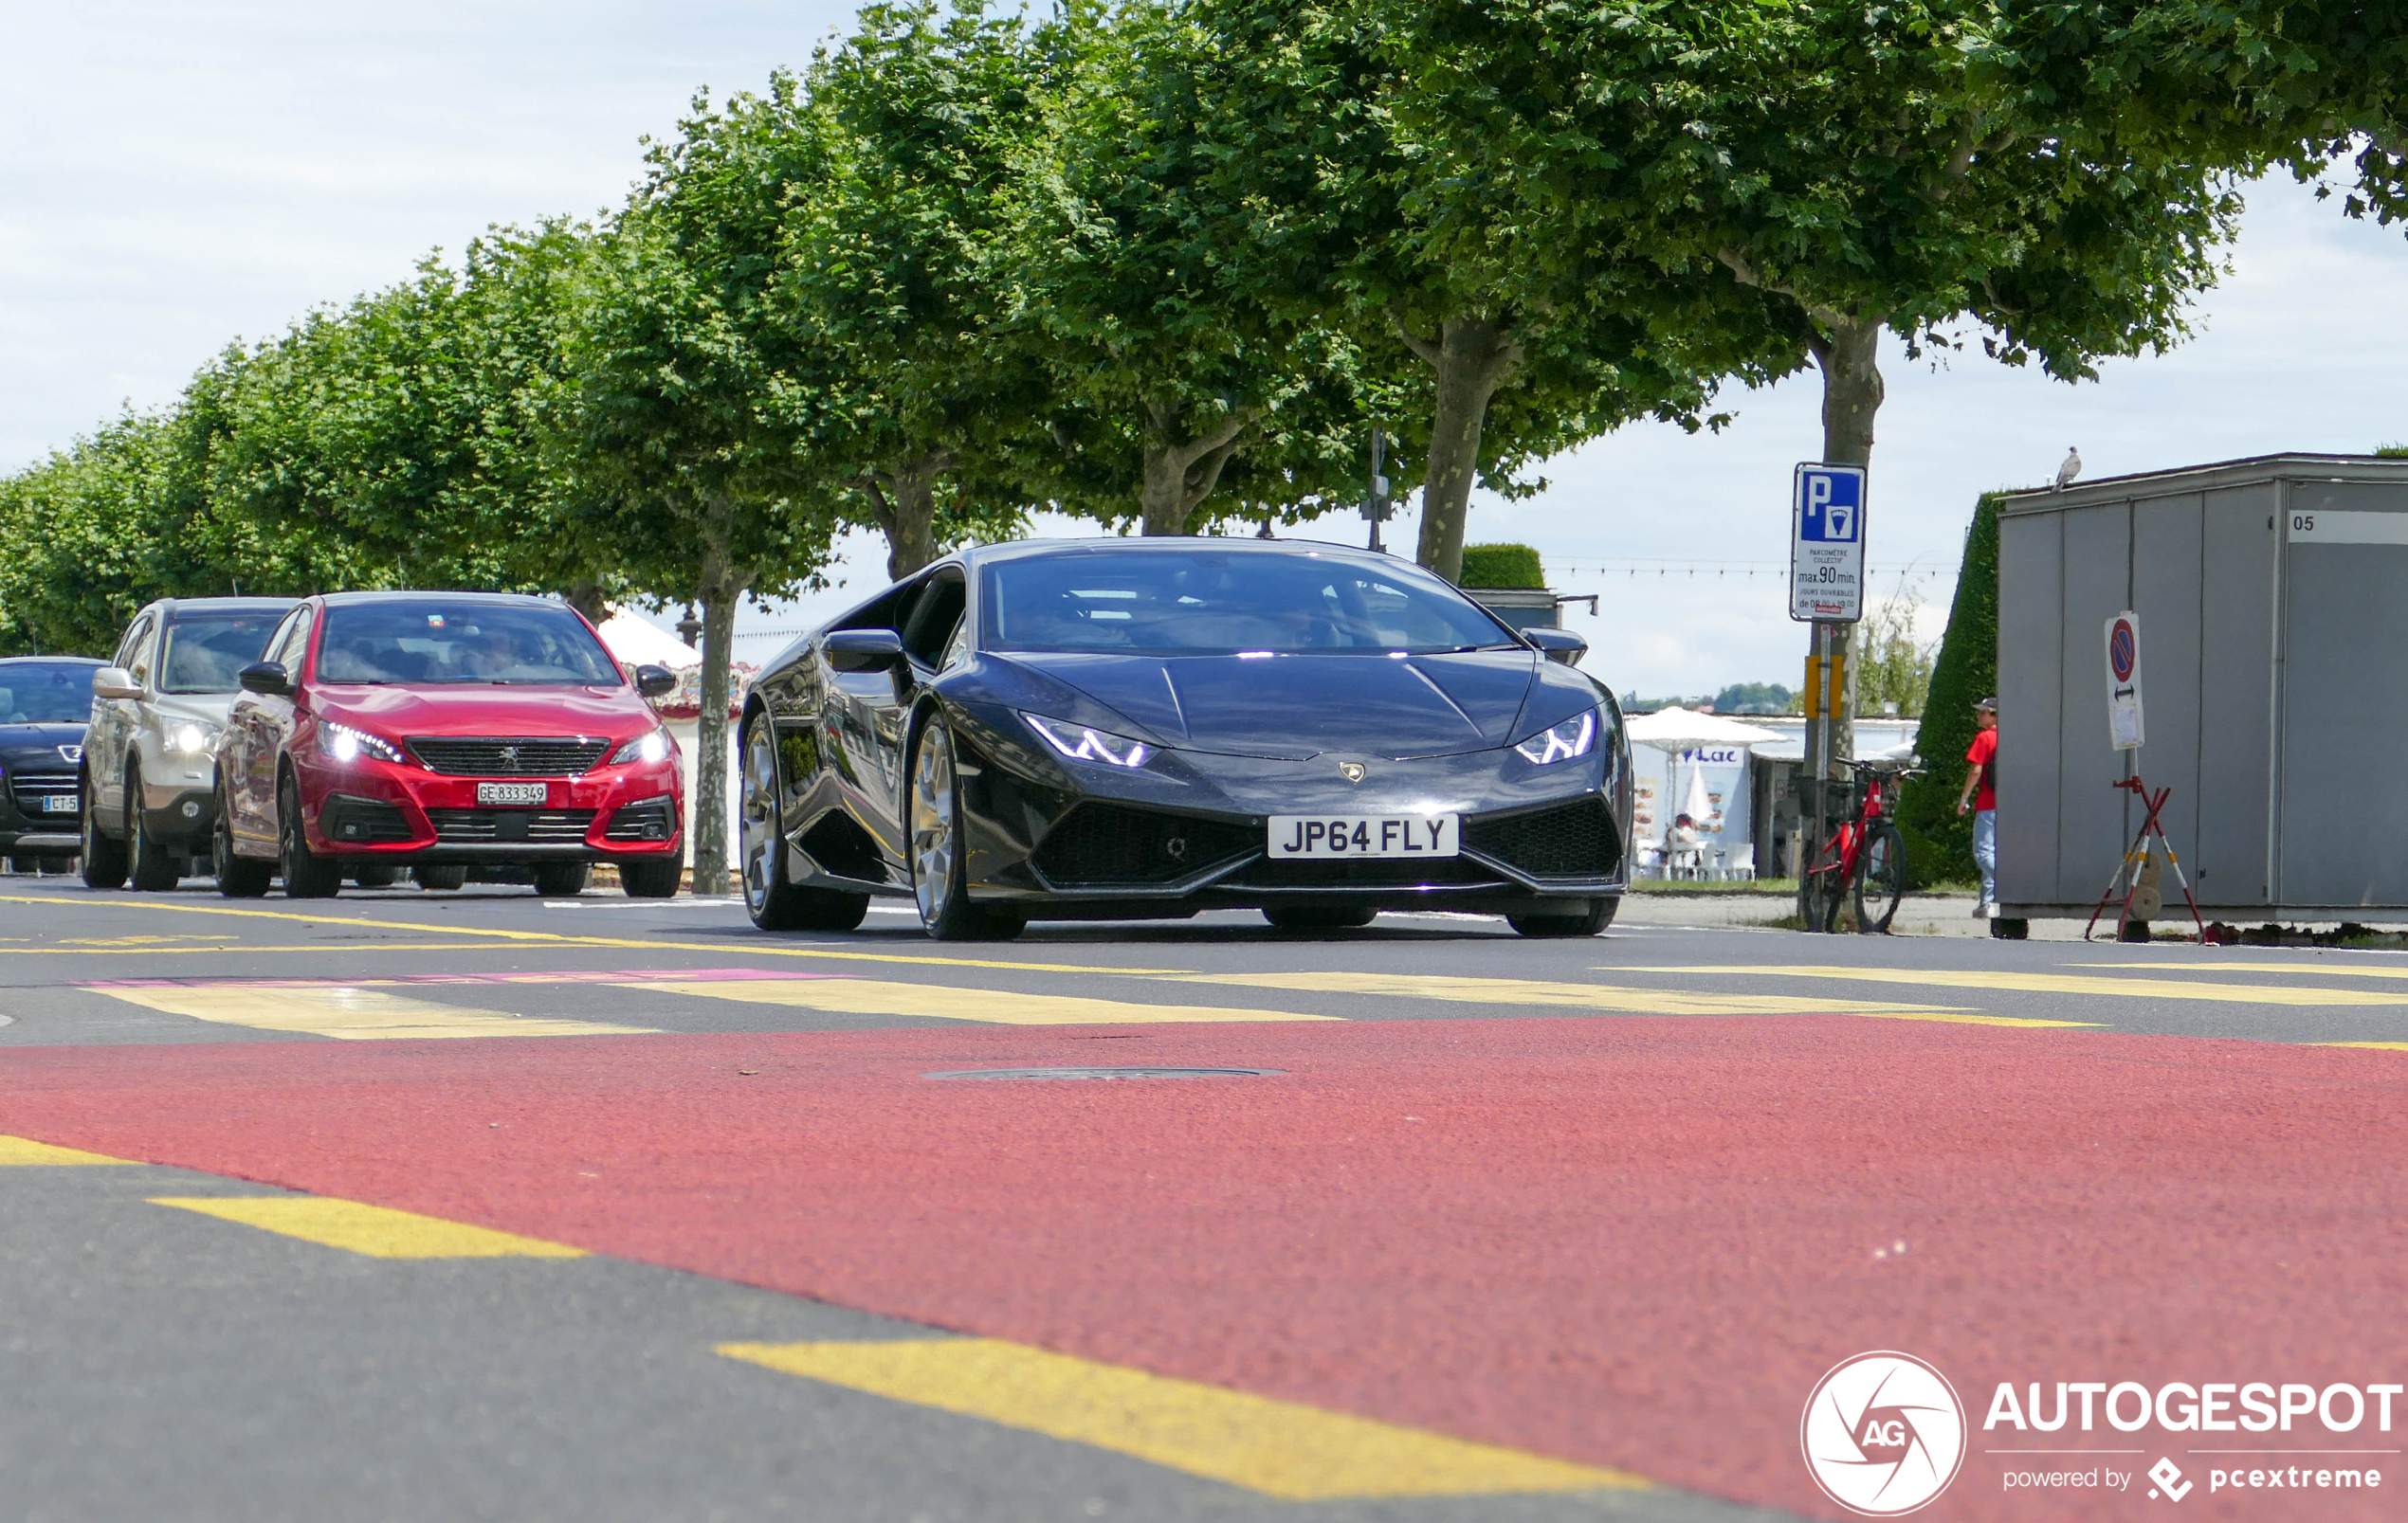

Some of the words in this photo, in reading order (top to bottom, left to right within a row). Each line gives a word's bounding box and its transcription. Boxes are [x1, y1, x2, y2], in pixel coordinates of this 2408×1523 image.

[1808, 475, 1833, 517] P
[2293, 516, 2314, 531] 05
[1819, 567, 1836, 583] 90
[1283, 821, 1371, 852] JP64
[1381, 820, 1445, 851] FLY
